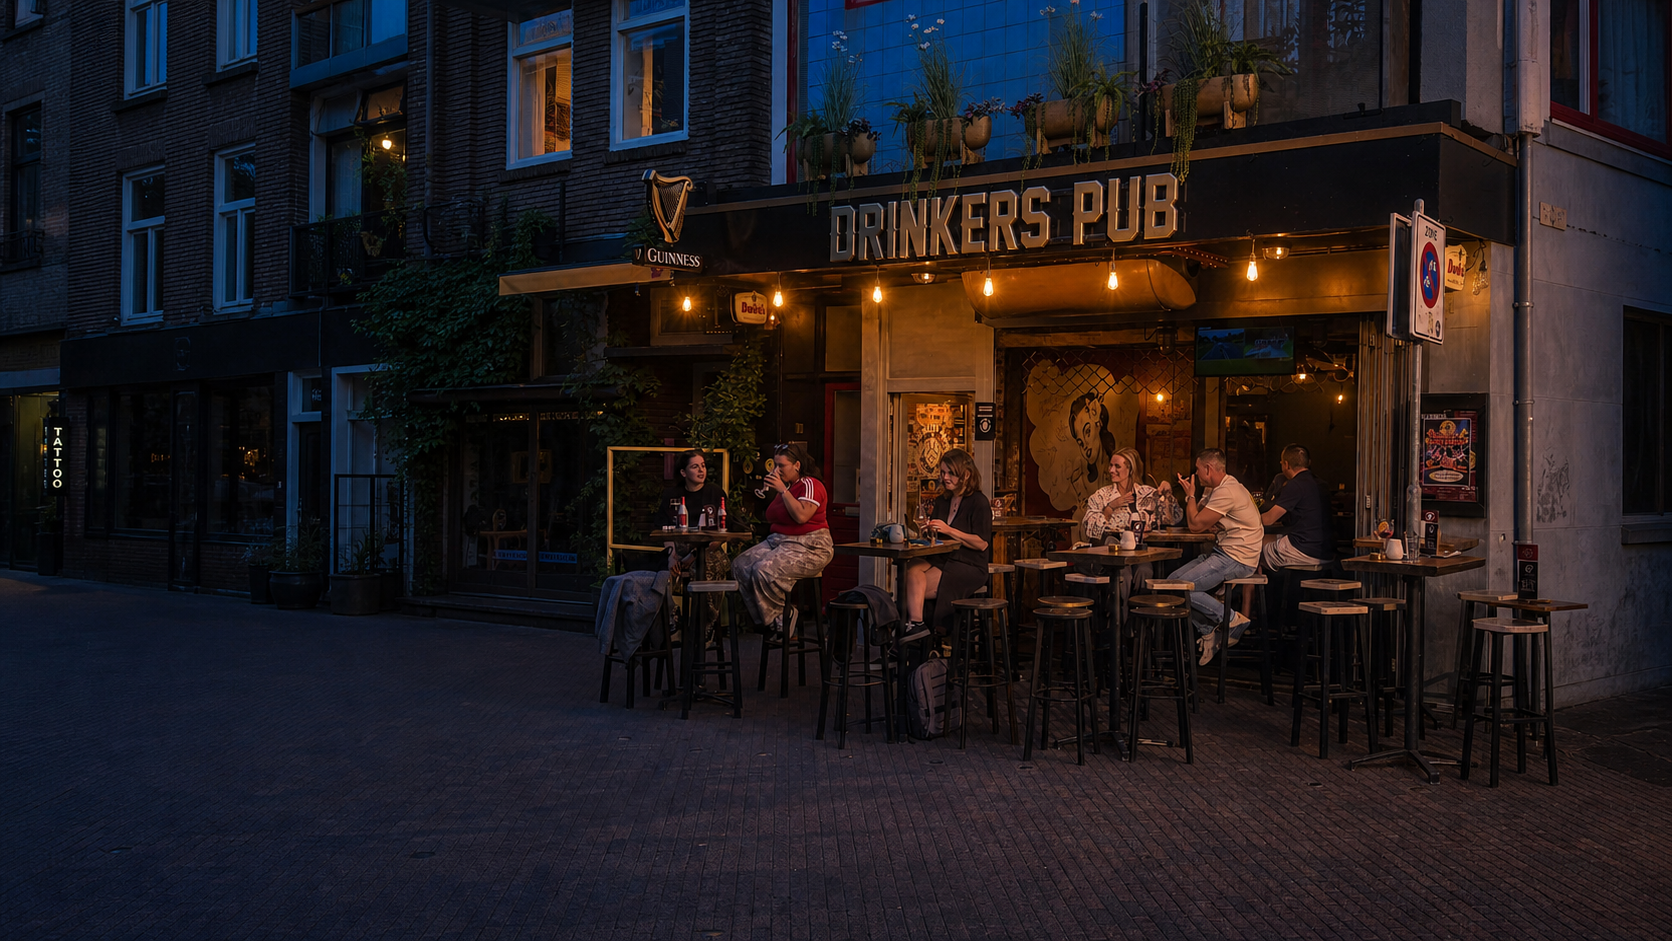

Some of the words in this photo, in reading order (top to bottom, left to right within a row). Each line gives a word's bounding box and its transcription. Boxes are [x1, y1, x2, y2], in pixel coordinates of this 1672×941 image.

[829, 185, 1052, 262] DRINKERS
[1072, 172, 1179, 246] PUB
[1425, 225, 1437, 241] ZONE
[647, 247, 701, 268] GUINNESS
[52, 427, 63, 488] TATTOO
